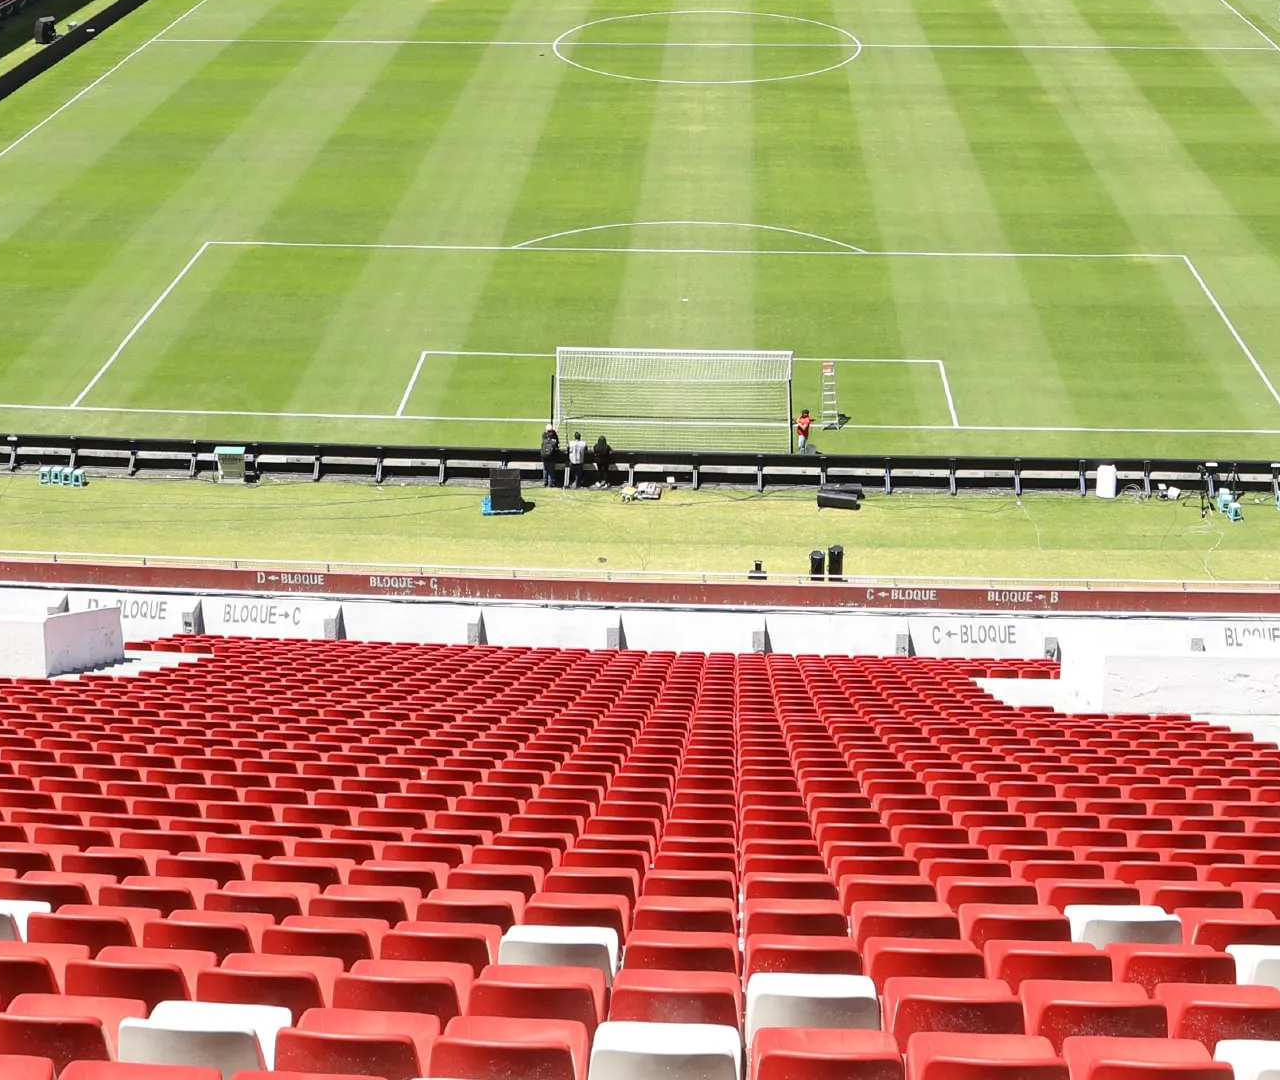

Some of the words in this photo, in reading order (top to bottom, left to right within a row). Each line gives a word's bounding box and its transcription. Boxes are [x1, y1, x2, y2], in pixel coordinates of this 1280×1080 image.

[256, 571, 266, 584] D
[280, 573, 325, 585] BLOQUE
[369, 575, 415, 588] BLOQUE
[866, 588, 875, 601] C
[890, 589, 937, 602] BLOQUE
[987, 590, 1034, 603] BLOQUE
[1050, 591, 1060, 604] B
[222, 603, 278, 625] BLOQUE
[292, 606, 302, 626] C
[931, 625, 942, 645] C
[960, 625, 1017, 644] BLOQUE
